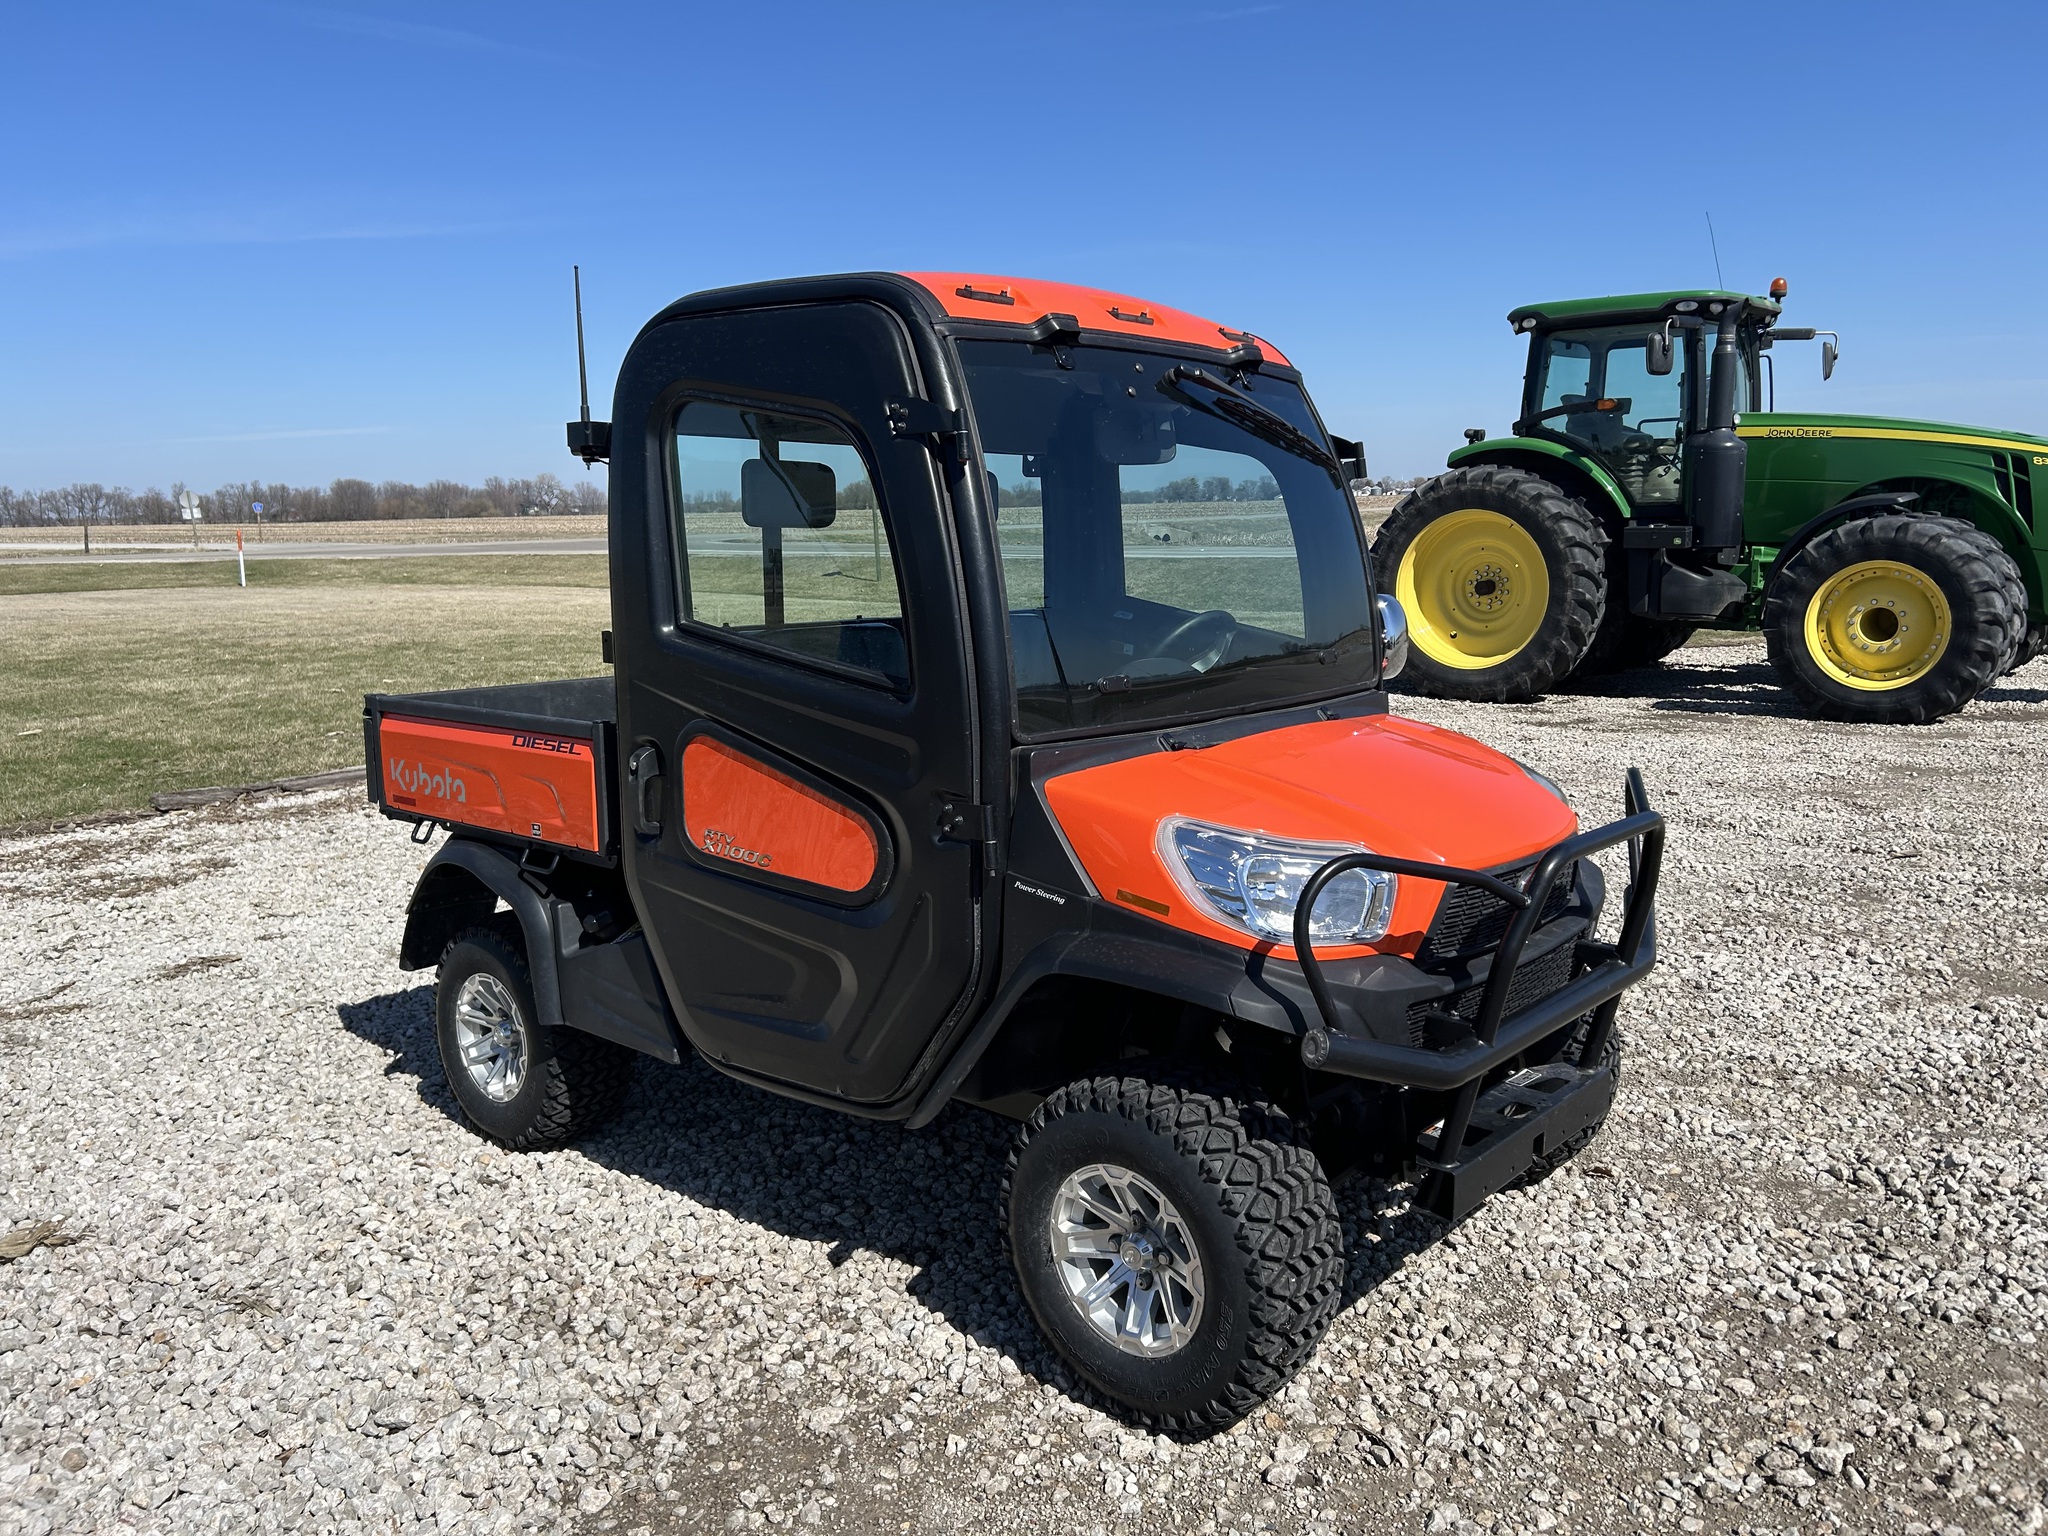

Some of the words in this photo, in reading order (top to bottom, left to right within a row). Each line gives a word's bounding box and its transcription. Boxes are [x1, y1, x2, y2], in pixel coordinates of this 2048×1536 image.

[1764, 427, 1794, 437] JOHN
[1796, 427, 1832, 437] DEERE
[512, 735, 581, 755] DIESEL
[390, 758, 466, 802] Kubota
[704, 829, 735, 844] RTV
[701, 839, 773, 867] X1100C
[1014, 881, 1036, 894] Power
[1035, 888, 1066, 905] Steering
